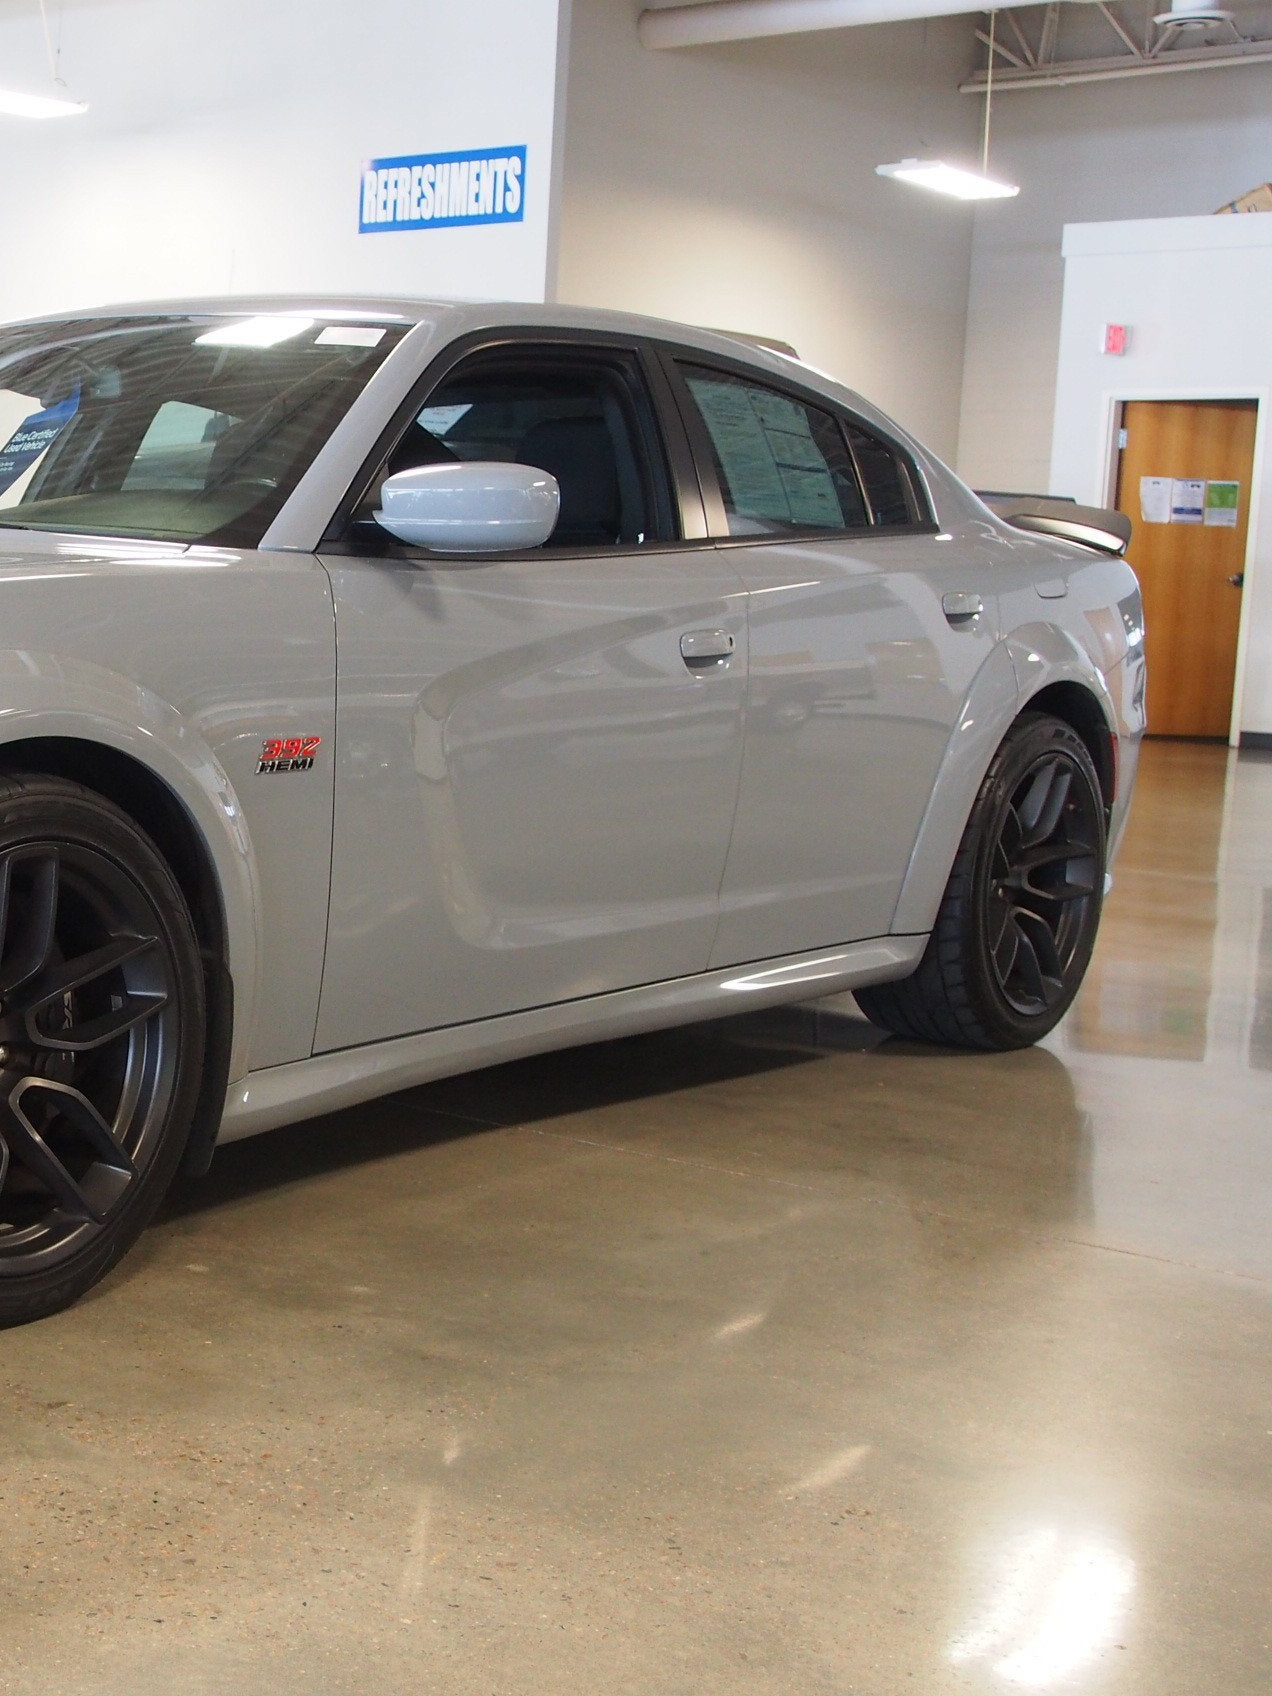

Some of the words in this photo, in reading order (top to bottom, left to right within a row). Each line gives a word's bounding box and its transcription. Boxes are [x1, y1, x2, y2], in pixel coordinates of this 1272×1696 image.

[362, 156, 522, 224] REFRESHMENTS
[259, 736, 322, 760] 392
[254, 757, 315, 774] HEMI
